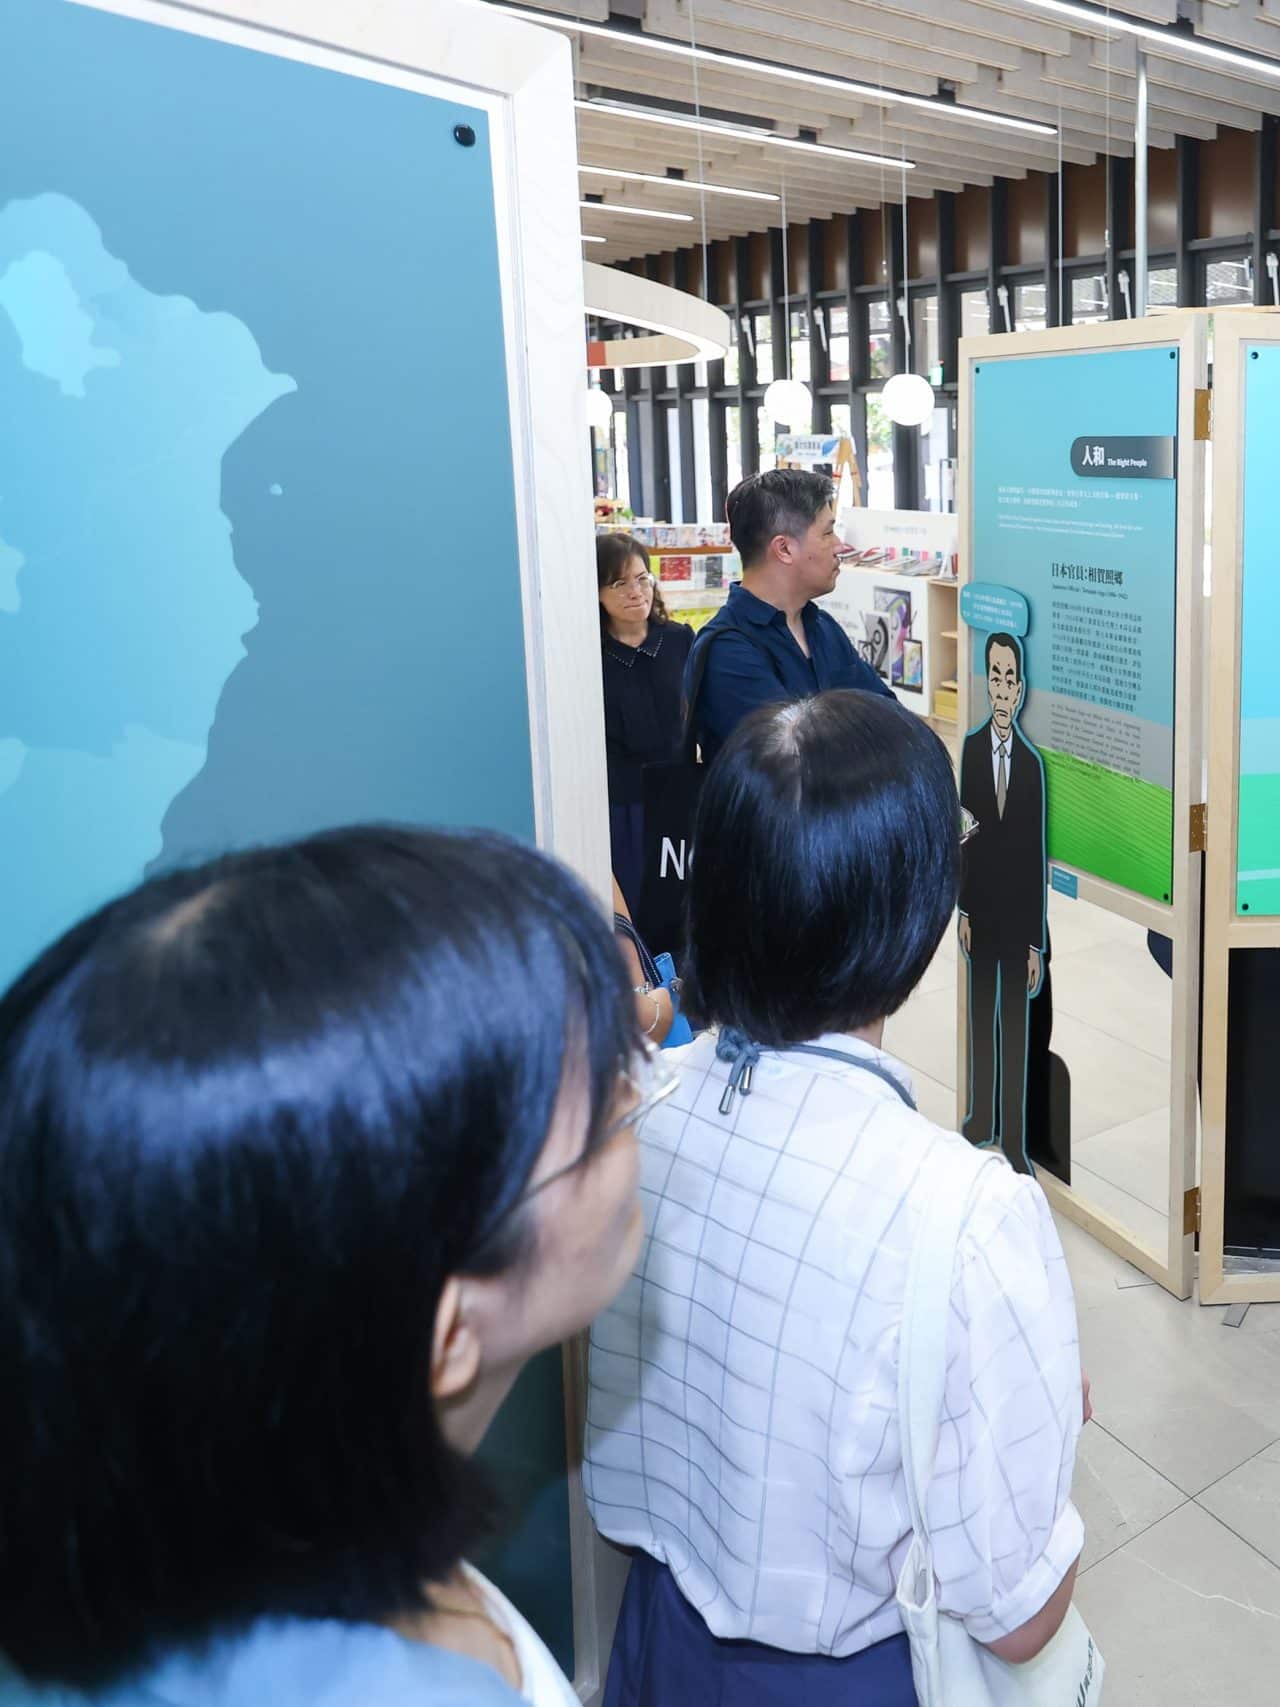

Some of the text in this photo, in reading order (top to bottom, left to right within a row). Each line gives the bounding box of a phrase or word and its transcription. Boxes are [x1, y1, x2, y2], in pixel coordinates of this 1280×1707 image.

[1081, 445, 1105, 466] 人和
[1107, 458, 1147, 469] The Right People
